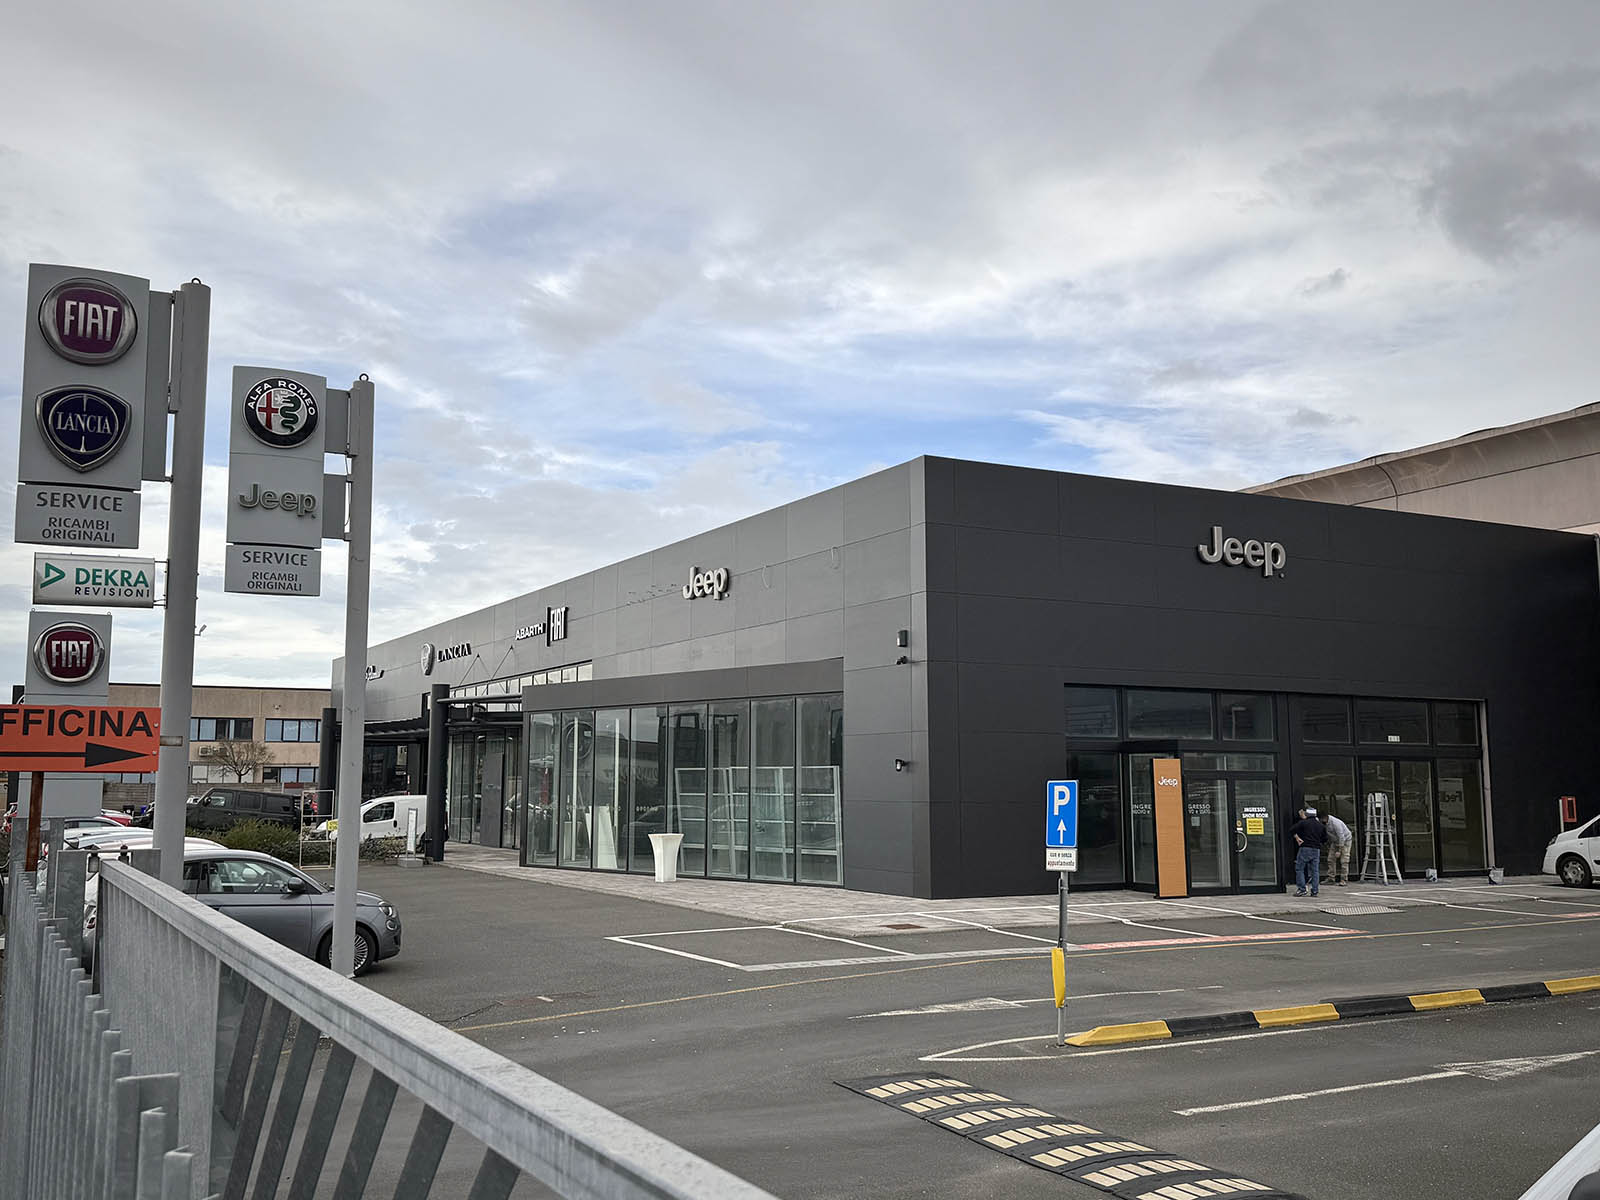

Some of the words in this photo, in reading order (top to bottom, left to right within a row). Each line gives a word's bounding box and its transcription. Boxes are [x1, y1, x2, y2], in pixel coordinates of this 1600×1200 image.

[64, 300, 118, 341] FIAT
[247, 382, 272, 409] ALFA
[278, 381, 316, 415] ROMEO
[56, 411, 112, 435] LANCIA
[36, 492, 123, 512] SERVICE
[239, 483, 316, 517] Jeep
[48, 517, 109, 530] RICAMBI
[42, 528, 115, 542] ORIGINALI
[242, 551, 308, 566] SERVICE
[1198, 525, 1286, 577] Jeep
[75, 567, 149, 588] DEKRA
[247, 580, 302, 592] ORIGINALI
[252, 571, 298, 582] RICAMBI
[682, 566, 730, 600] Jeep
[74, 586, 150, 598] REVISIONI
[515, 622, 546, 640] ABARTH
[550, 606, 569, 641] FIAT
[51, 640, 90, 668] FIAT
[437, 643, 472, 662] LANCIA
[1158, 776, 1178, 787] Jeep
[1053, 785, 1071, 816] P
